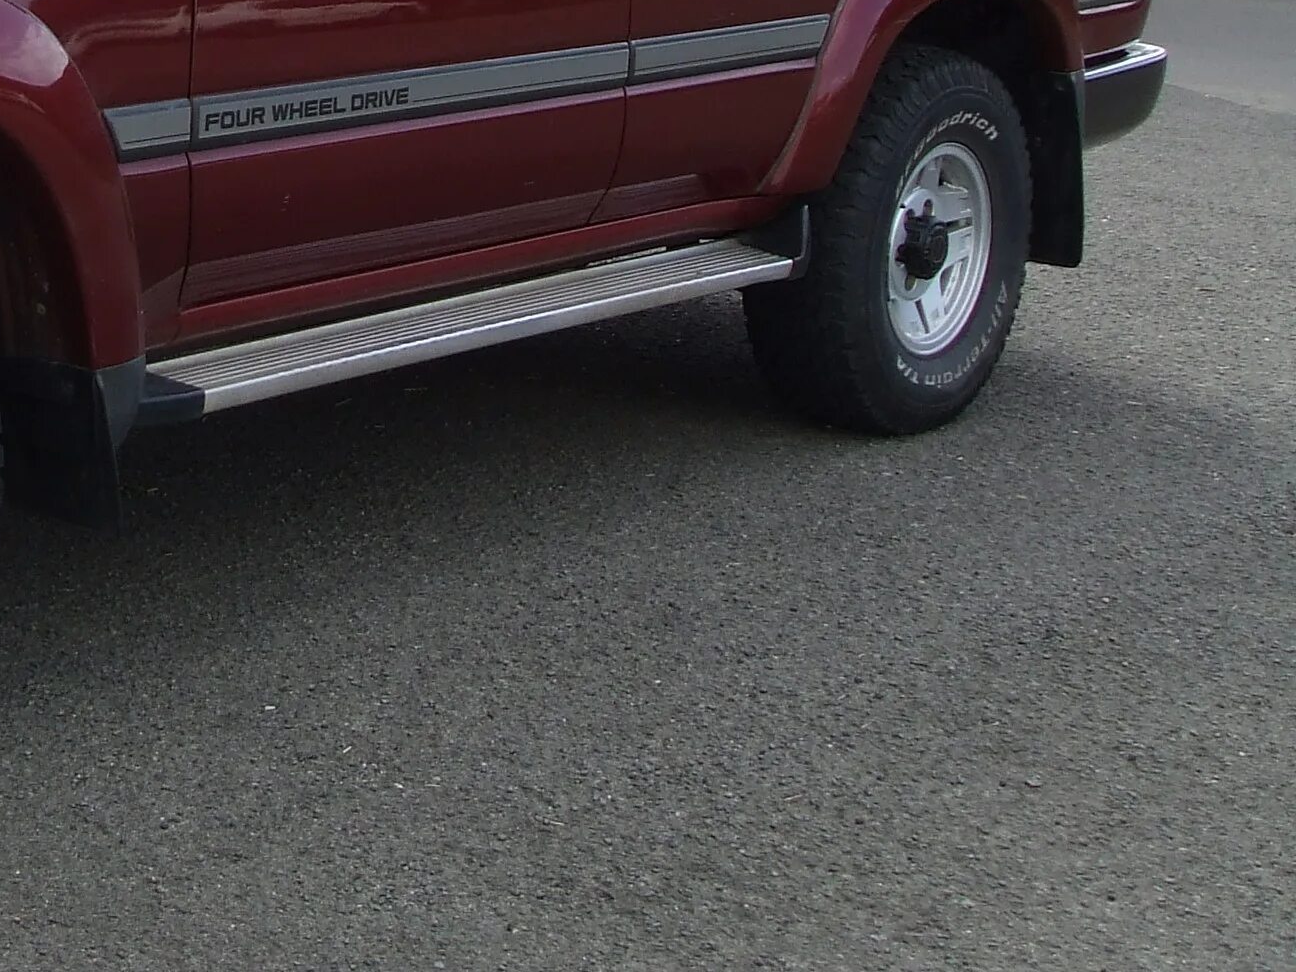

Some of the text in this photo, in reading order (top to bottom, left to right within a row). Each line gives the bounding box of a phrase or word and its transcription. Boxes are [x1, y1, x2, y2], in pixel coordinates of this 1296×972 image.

[205, 87, 409, 131] FOUR WHEEL DRIVE
